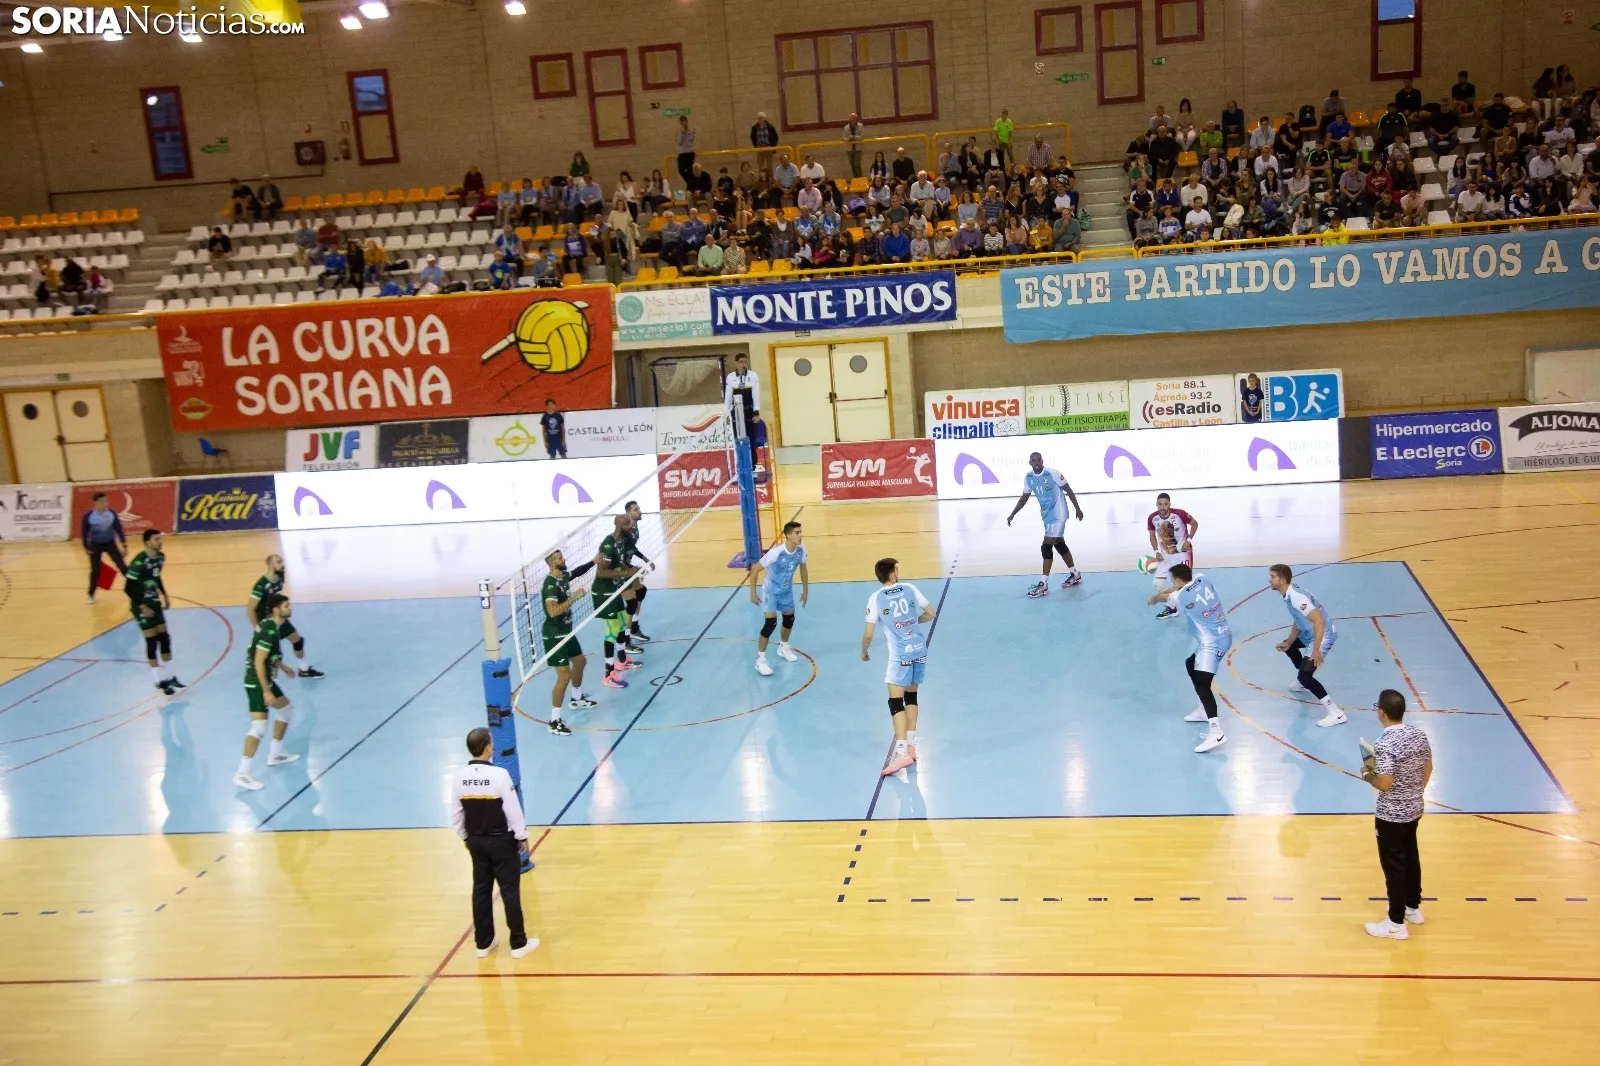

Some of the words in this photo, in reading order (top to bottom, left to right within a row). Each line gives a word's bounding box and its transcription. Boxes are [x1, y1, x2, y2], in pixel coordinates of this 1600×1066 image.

[1014, 271, 1111, 310] ESTE
[1123, 258, 1297, 301] PARTIDO
[1309, 253, 1361, 290] LO
[1372, 242, 1523, 285] VAMOS
[1533, 239, 1569, 275] A
[716, 290, 837, 327] MONTE
[844, 281, 952, 318] PINOS
[221, 323, 281, 367] LA
[292, 312, 451, 364] CURVA
[235, 364, 453, 417] SORIANA
[1155, 382, 1181, 391] Soria
[1183, 380, 1206, 390] 88.1
[1189, 391, 1212, 400] 93.2
[932, 394, 1020, 421] vinuesa
[567, 426, 613, 436] CASTILLA
[618, 424, 625, 435] Y
[628, 421, 653, 433] LEÓN
[1061, 417, 1073, 426] DE
[1074, 414, 1128, 425] FISIOTERAPIA
[1152, 418, 1189, 428] Castilla
[1376, 418, 1492, 439] Hipermercado
[932, 421, 995, 440] climalit
[303, 430, 360, 462] JVF
[1376, 444, 1466, 461] E.Leclerc
[827, 457, 886, 479] SVM
[1435, 458, 1463, 470] Soria
[1568, 456, 1580, 464] DE
[664, 467, 721, 488] SVM
[826, 480, 856, 489] SUPERLIGA
[856, 479, 881, 488] VOLEIBOL
[881, 477, 913, 486] MASCULINA
[181, 493, 259, 521] Real
[1195, 586, 1215, 606] 14
[889, 598, 909, 618] 20
